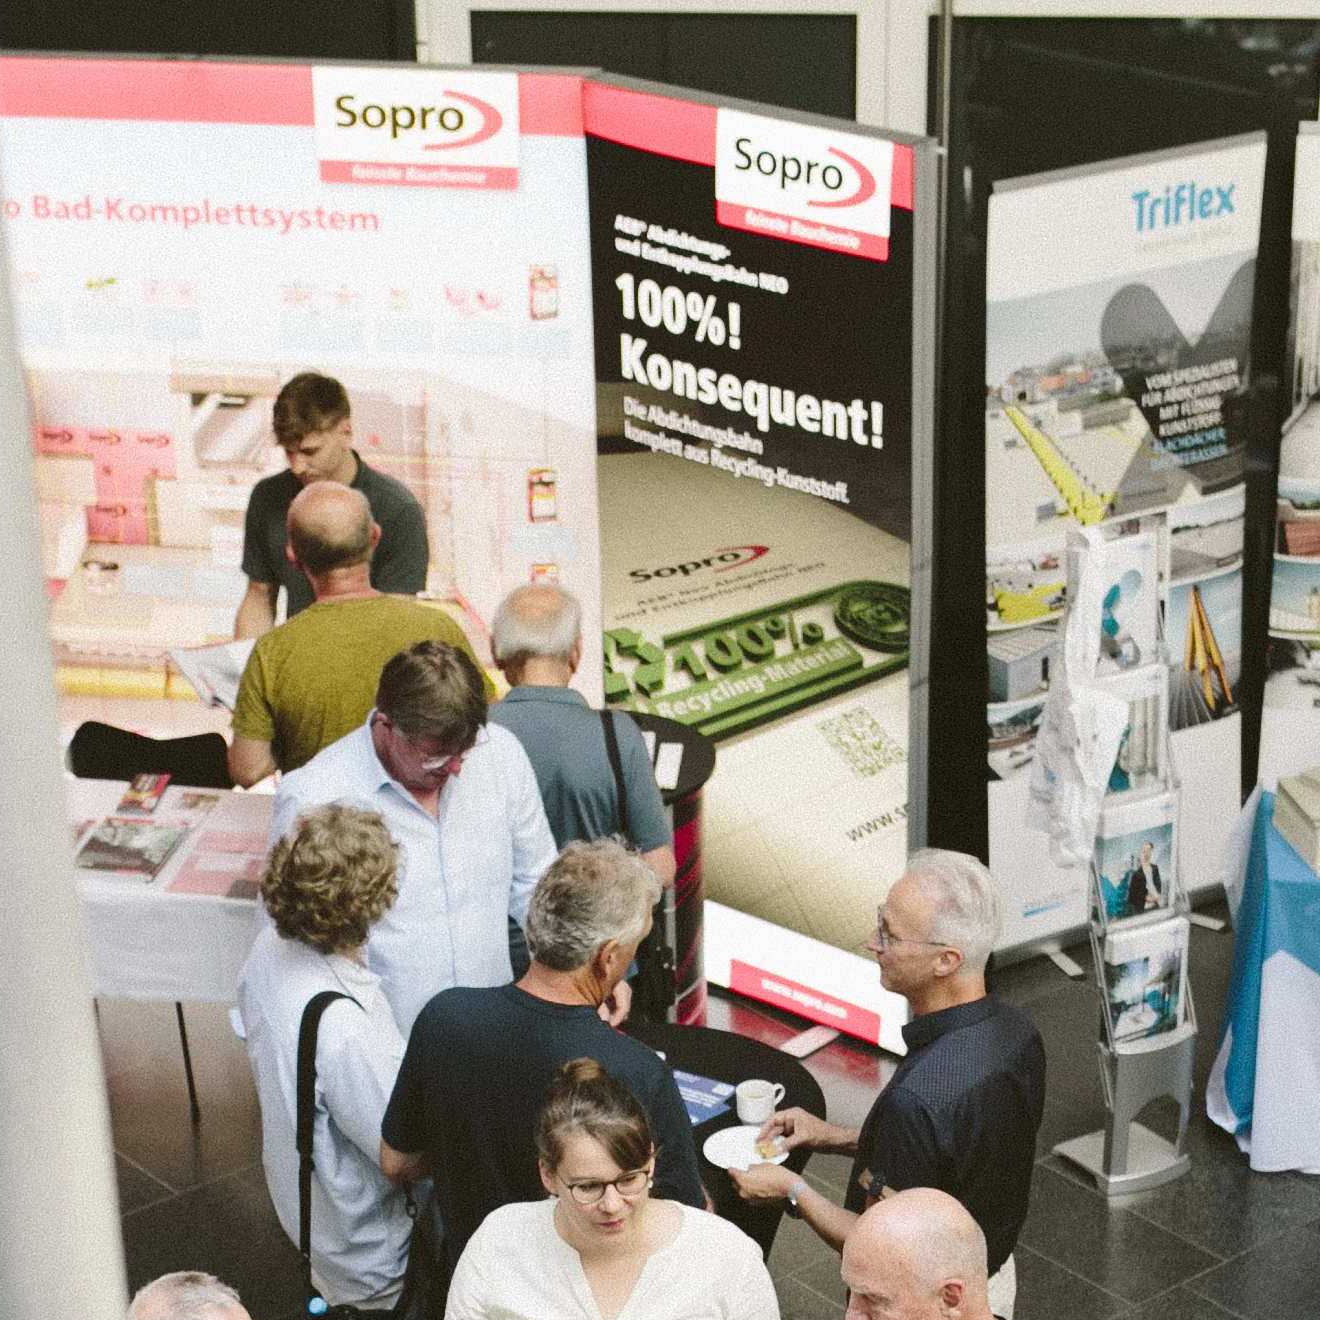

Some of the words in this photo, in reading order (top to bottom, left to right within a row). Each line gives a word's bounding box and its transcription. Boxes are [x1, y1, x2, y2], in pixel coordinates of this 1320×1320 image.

[335, 95, 465, 138] Sopro
[734, 138, 844, 190] Sopro
[33, 195, 380, 233] Bad-Komplettsystem
[1131, 183, 1235, 232] Triflex
[614, 273, 741, 350] 100%!
[620, 334, 885, 449] Konsequent!
[629, 552, 740, 584] Sopro
[672, 612, 824, 682] 100%
[655, 638, 851, 718] Recycling-Material
